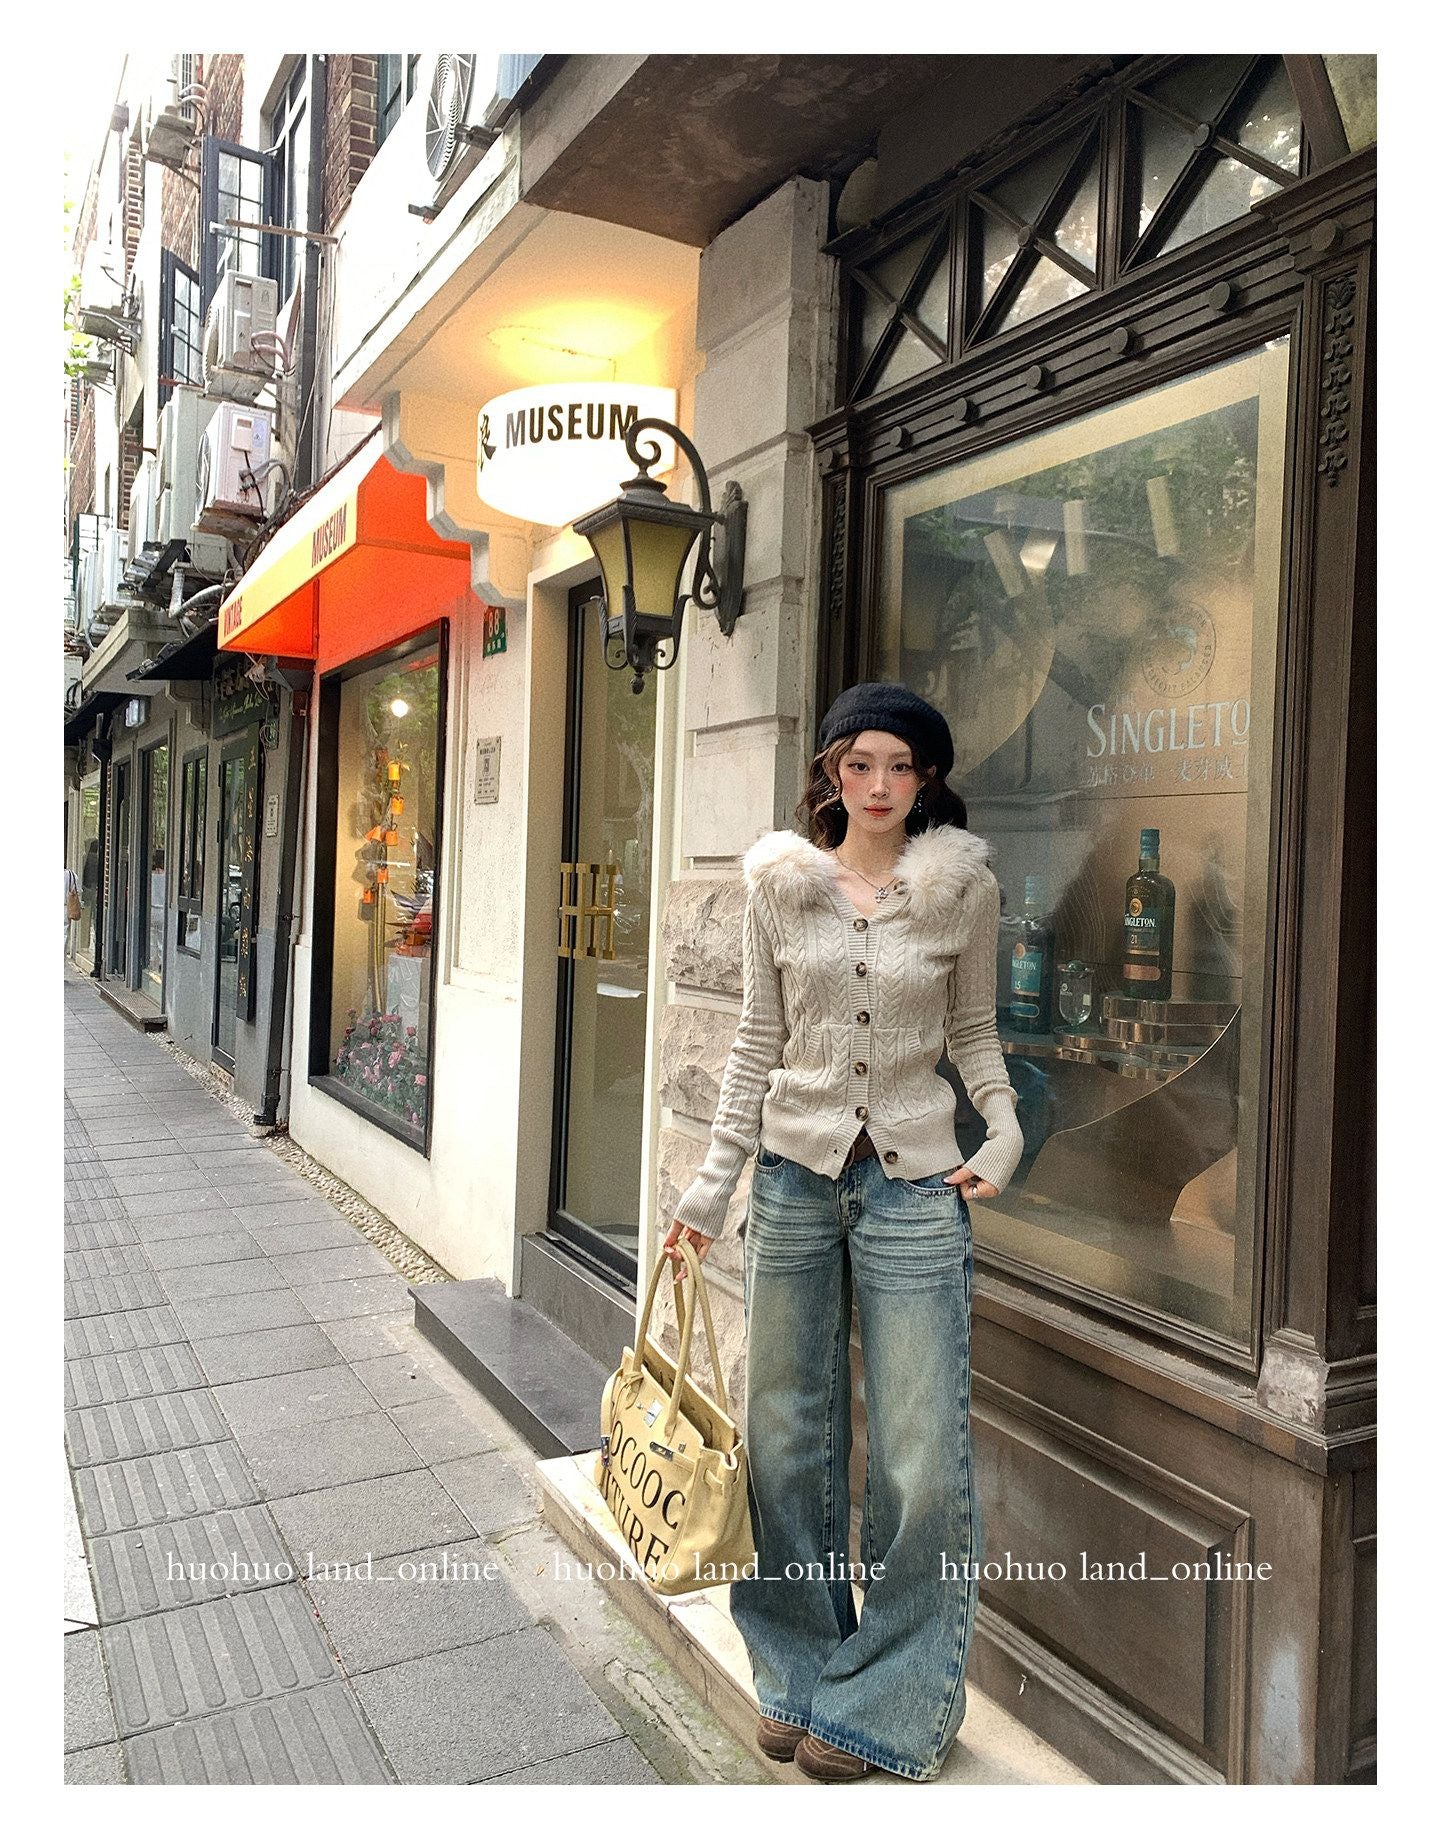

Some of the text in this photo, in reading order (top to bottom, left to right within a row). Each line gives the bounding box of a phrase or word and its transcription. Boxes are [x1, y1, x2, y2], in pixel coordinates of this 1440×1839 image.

[506, 403, 638, 449] MUSEUM
[311, 502, 347, 568] MUSEUM
[1086, 698, 1250, 758] SINGLETO
